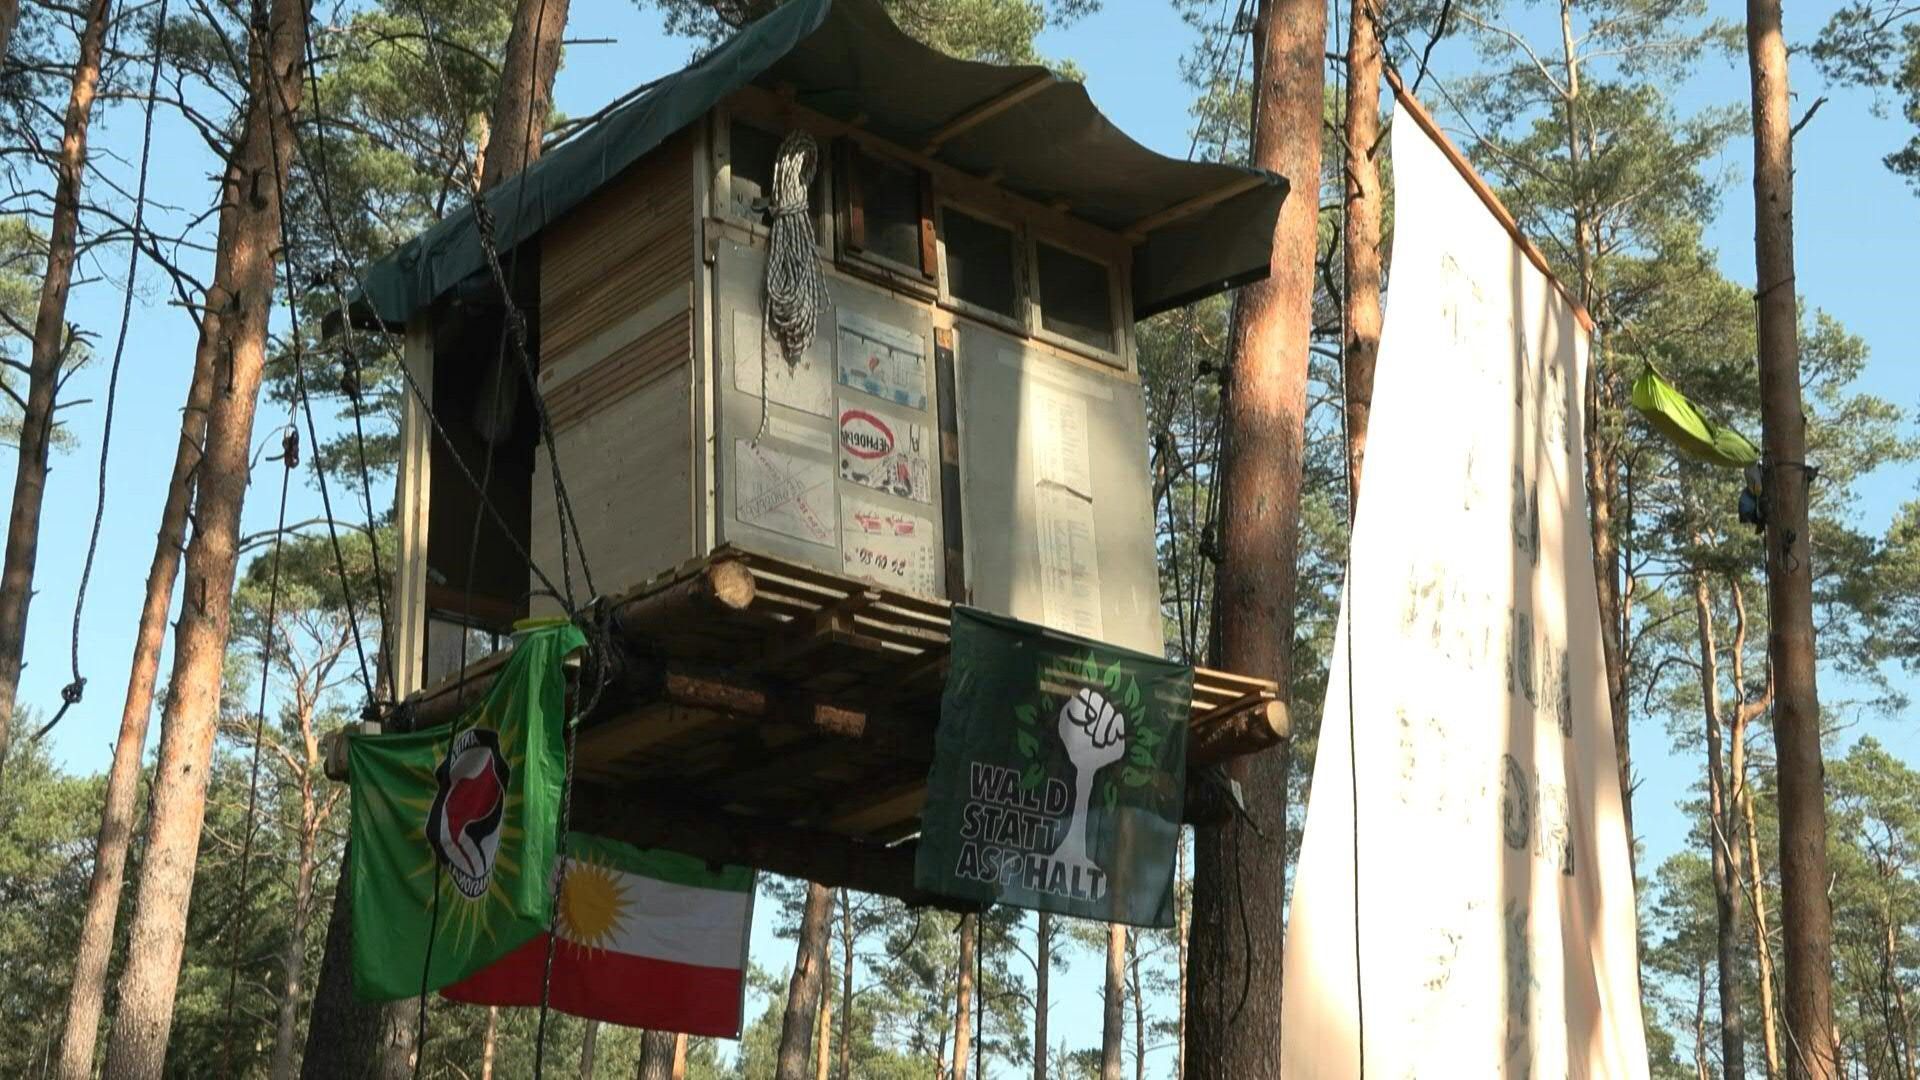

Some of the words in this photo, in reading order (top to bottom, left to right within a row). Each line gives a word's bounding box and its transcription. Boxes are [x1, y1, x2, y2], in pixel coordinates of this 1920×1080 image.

[970, 761, 1068, 815] WALD
[961, 803, 1060, 850] STATT
[955, 842, 1106, 901] ASPHALT
